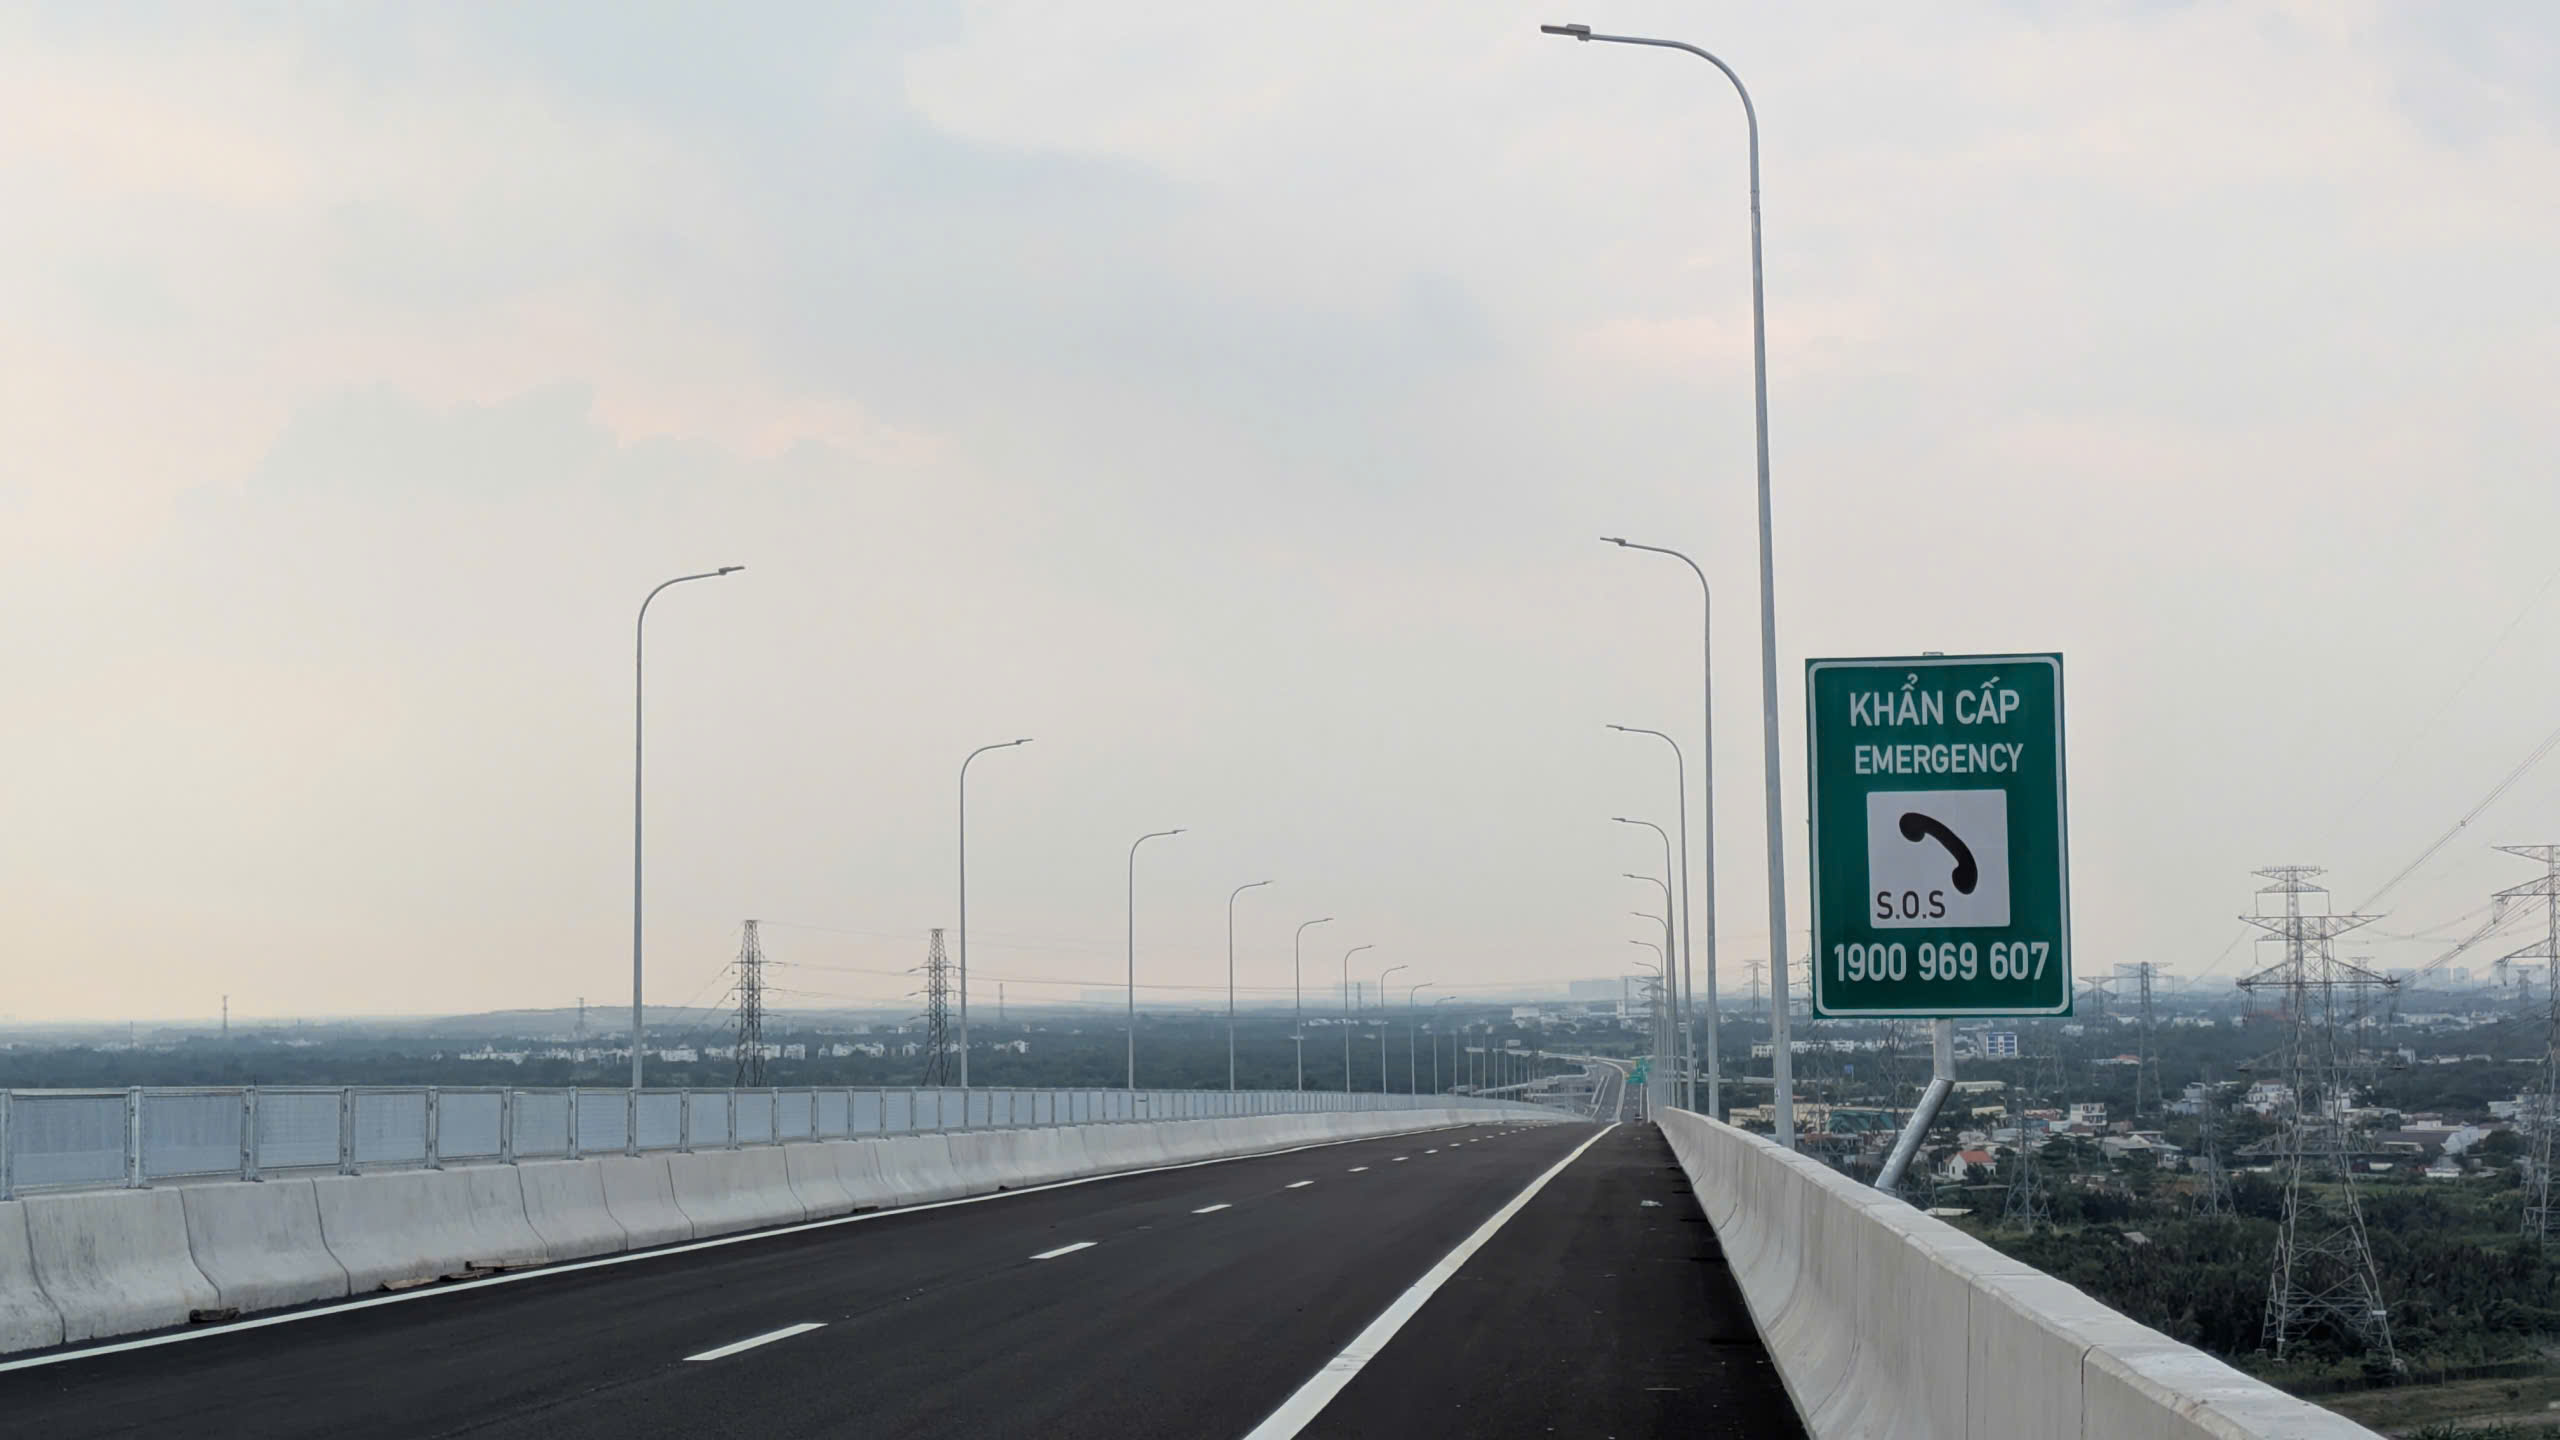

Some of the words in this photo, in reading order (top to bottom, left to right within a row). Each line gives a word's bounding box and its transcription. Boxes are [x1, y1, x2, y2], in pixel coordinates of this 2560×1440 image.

[1849, 674, 1944, 727] KHẨN
[1955, 676, 2020, 725] CẤP
[1855, 743, 2024, 774] EMERGENCY
[1876, 890, 1946, 919] S.O.S
[1833, 943, 1907, 982] 1900
[1918, 942, 1978, 981] 969
[1989, 941, 2050, 980] 607
